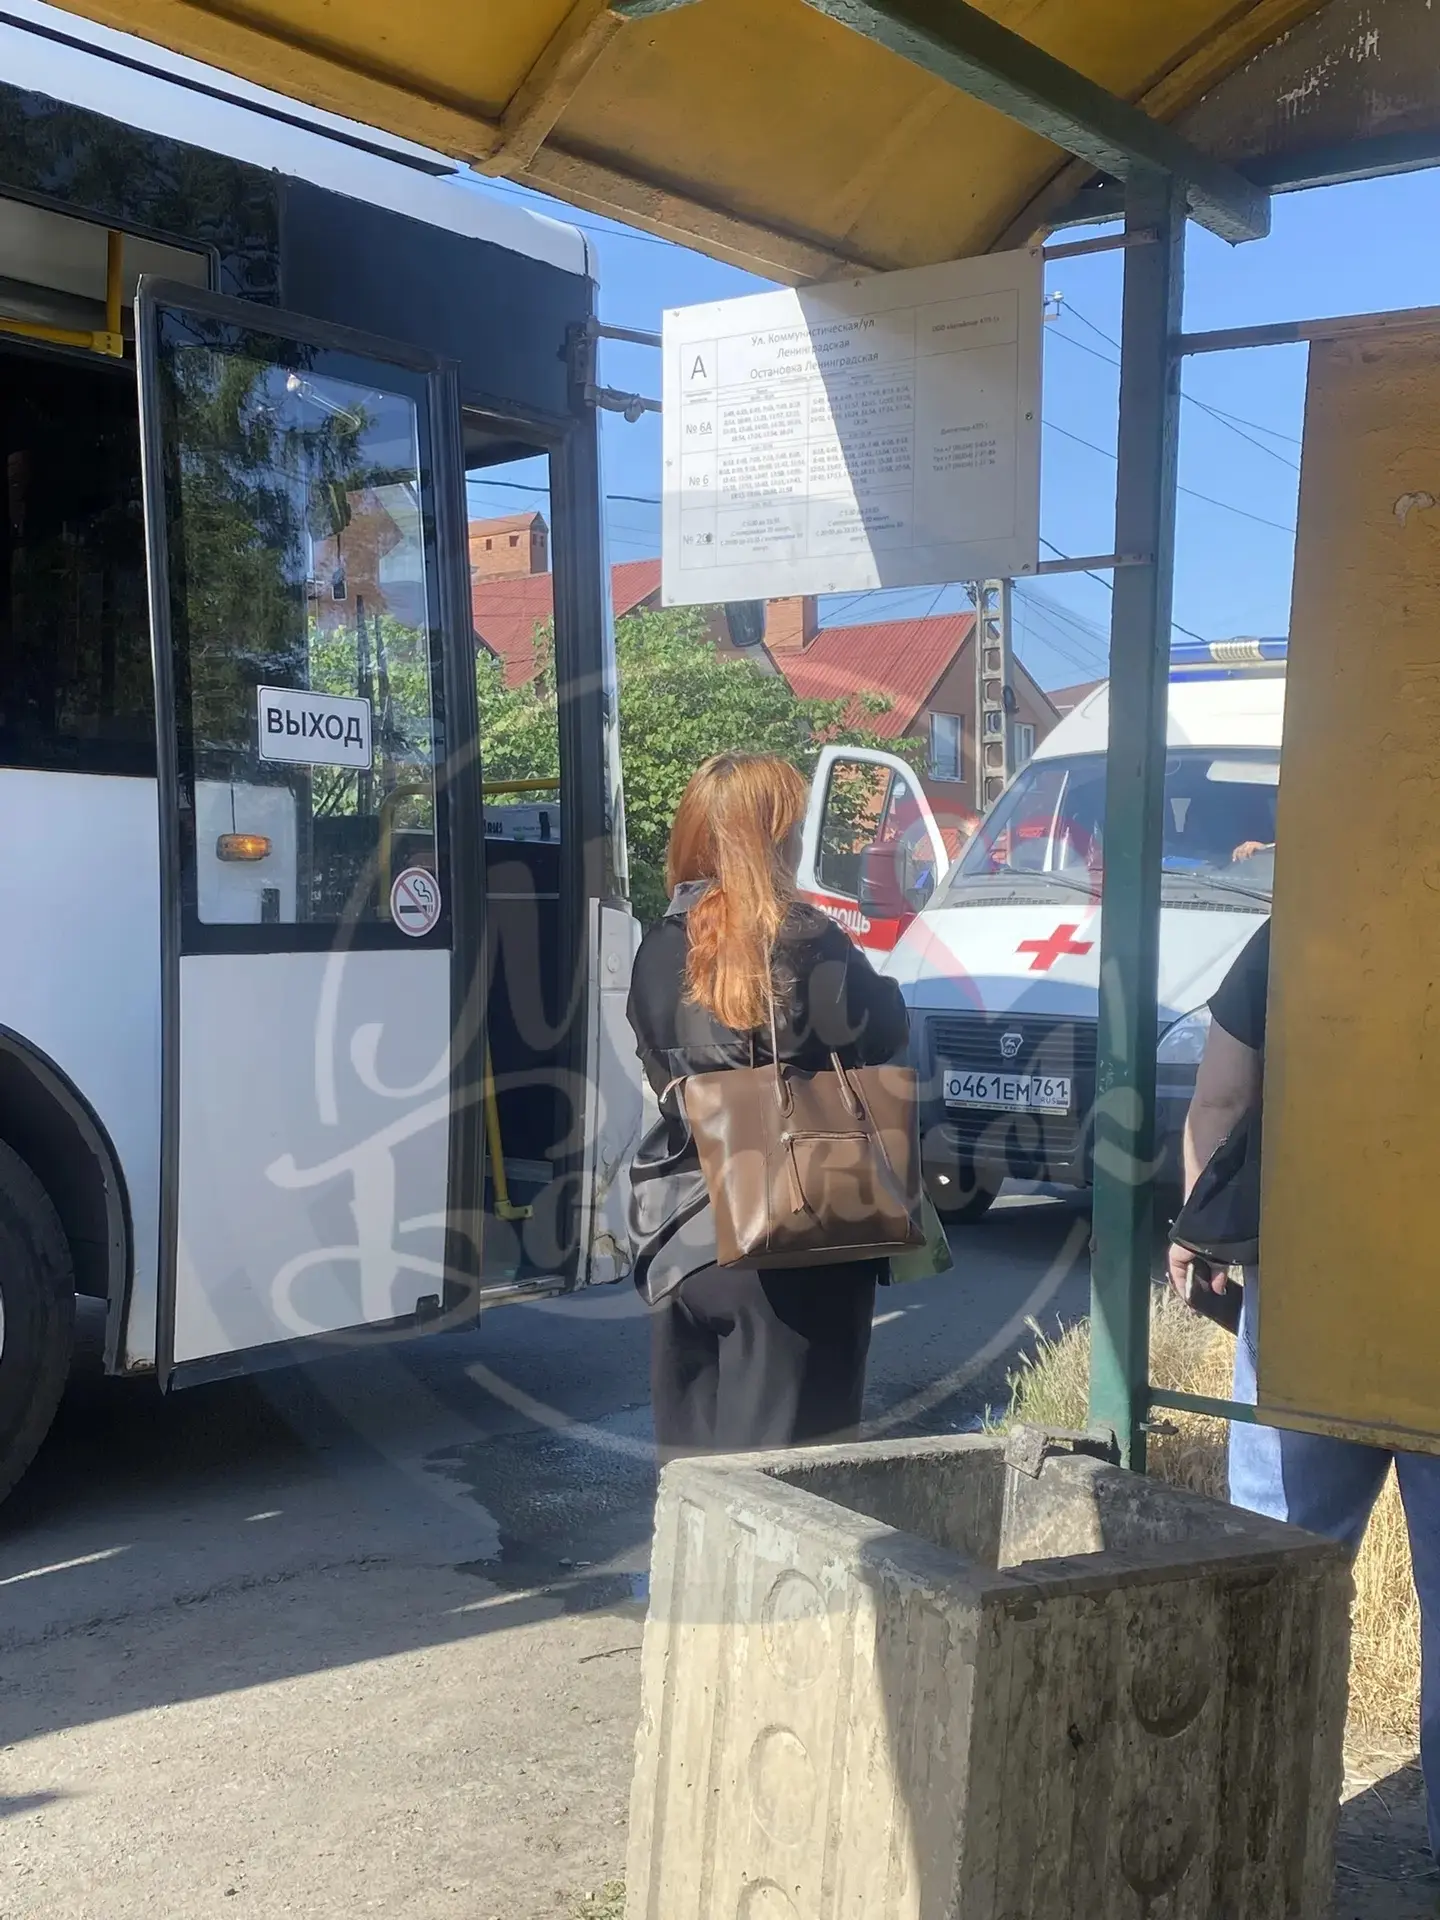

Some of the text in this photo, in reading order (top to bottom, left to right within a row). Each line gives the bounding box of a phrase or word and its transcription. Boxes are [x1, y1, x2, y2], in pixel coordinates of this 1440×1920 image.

[768, 318, 875, 343] Коммунистическая/ул
[777, 339, 851, 359] Ленинградская
[691, 355, 708, 380] А
[750, 363, 803, 380] Остановка
[805, 351, 879, 372] Ленинградская
[686, 421, 713, 434] № 6А
[688, 475, 709, 487] № 6
[266, 707, 363, 749] ВЫХОД
[1032, 1077, 1066, 1098] 761
[1040, 1096, 1057, 1105] RUS
